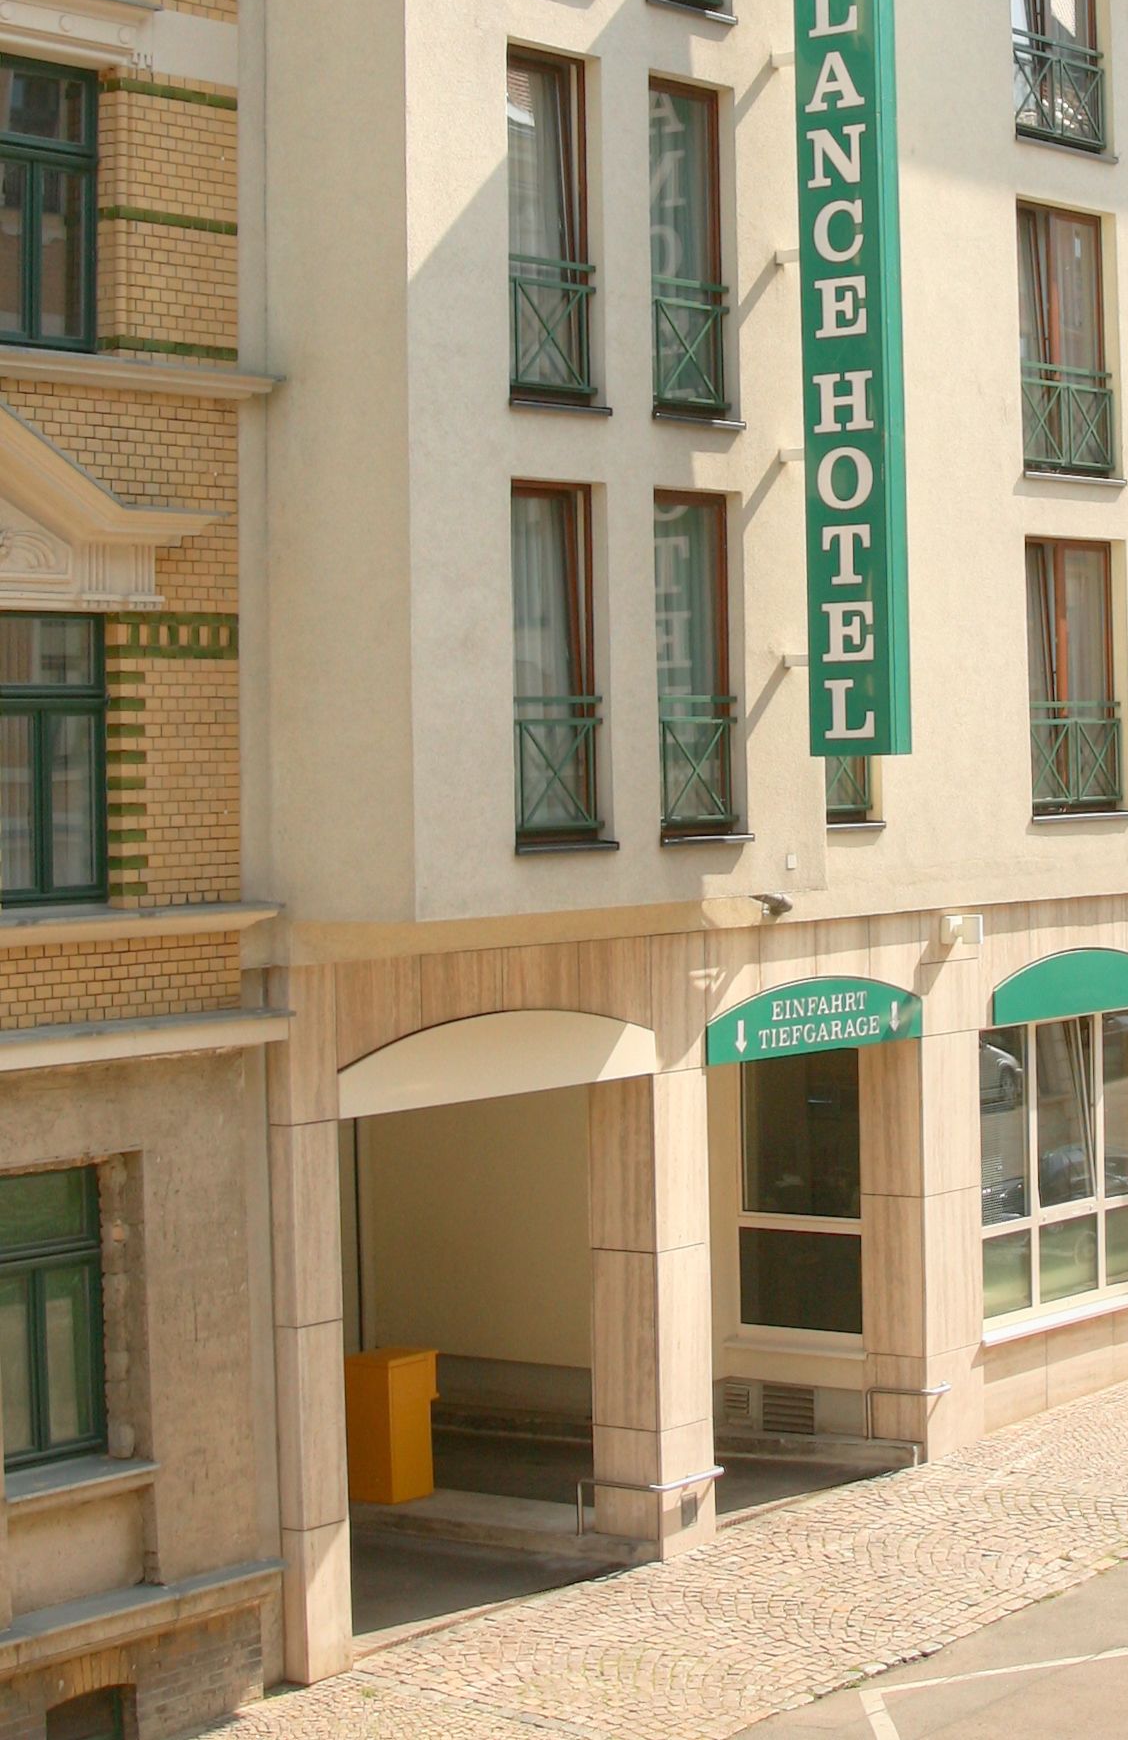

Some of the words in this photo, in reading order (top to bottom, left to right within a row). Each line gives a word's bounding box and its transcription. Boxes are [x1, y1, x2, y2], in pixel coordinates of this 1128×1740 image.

[812, 370, 876, 740] HOTEL
[772, 991, 868, 1022] EINFAHRT
[758, 1015, 881, 1050] TIEFGARAGE
